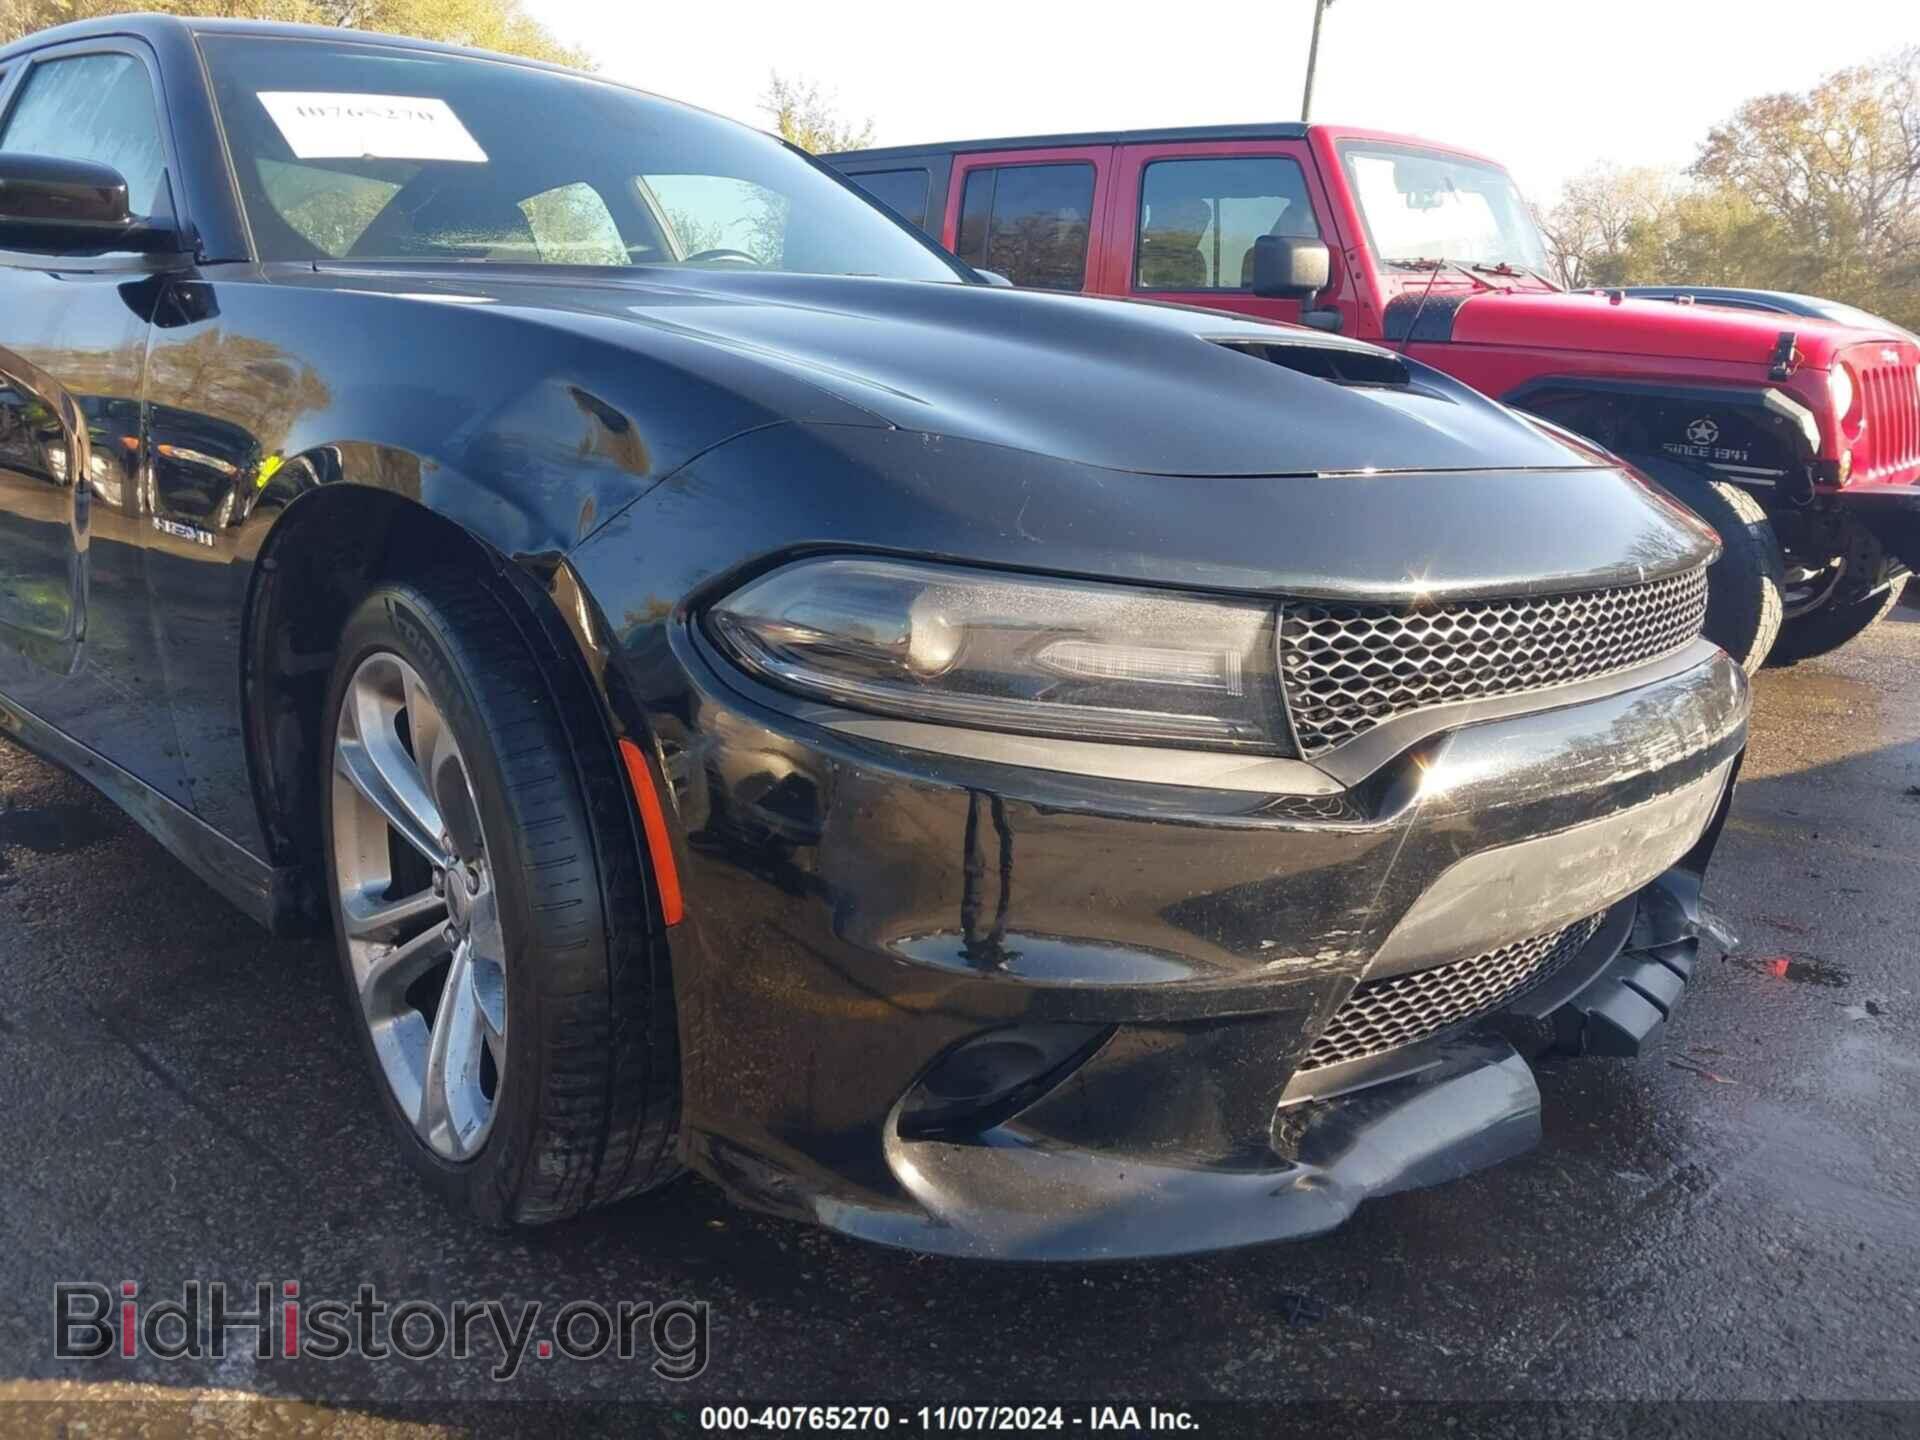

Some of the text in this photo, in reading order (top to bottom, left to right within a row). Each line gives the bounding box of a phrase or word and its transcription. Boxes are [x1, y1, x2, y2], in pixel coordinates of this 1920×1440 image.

[1663, 443, 1748, 461] SINCE 1941
[152, 516, 213, 547] HEMI
